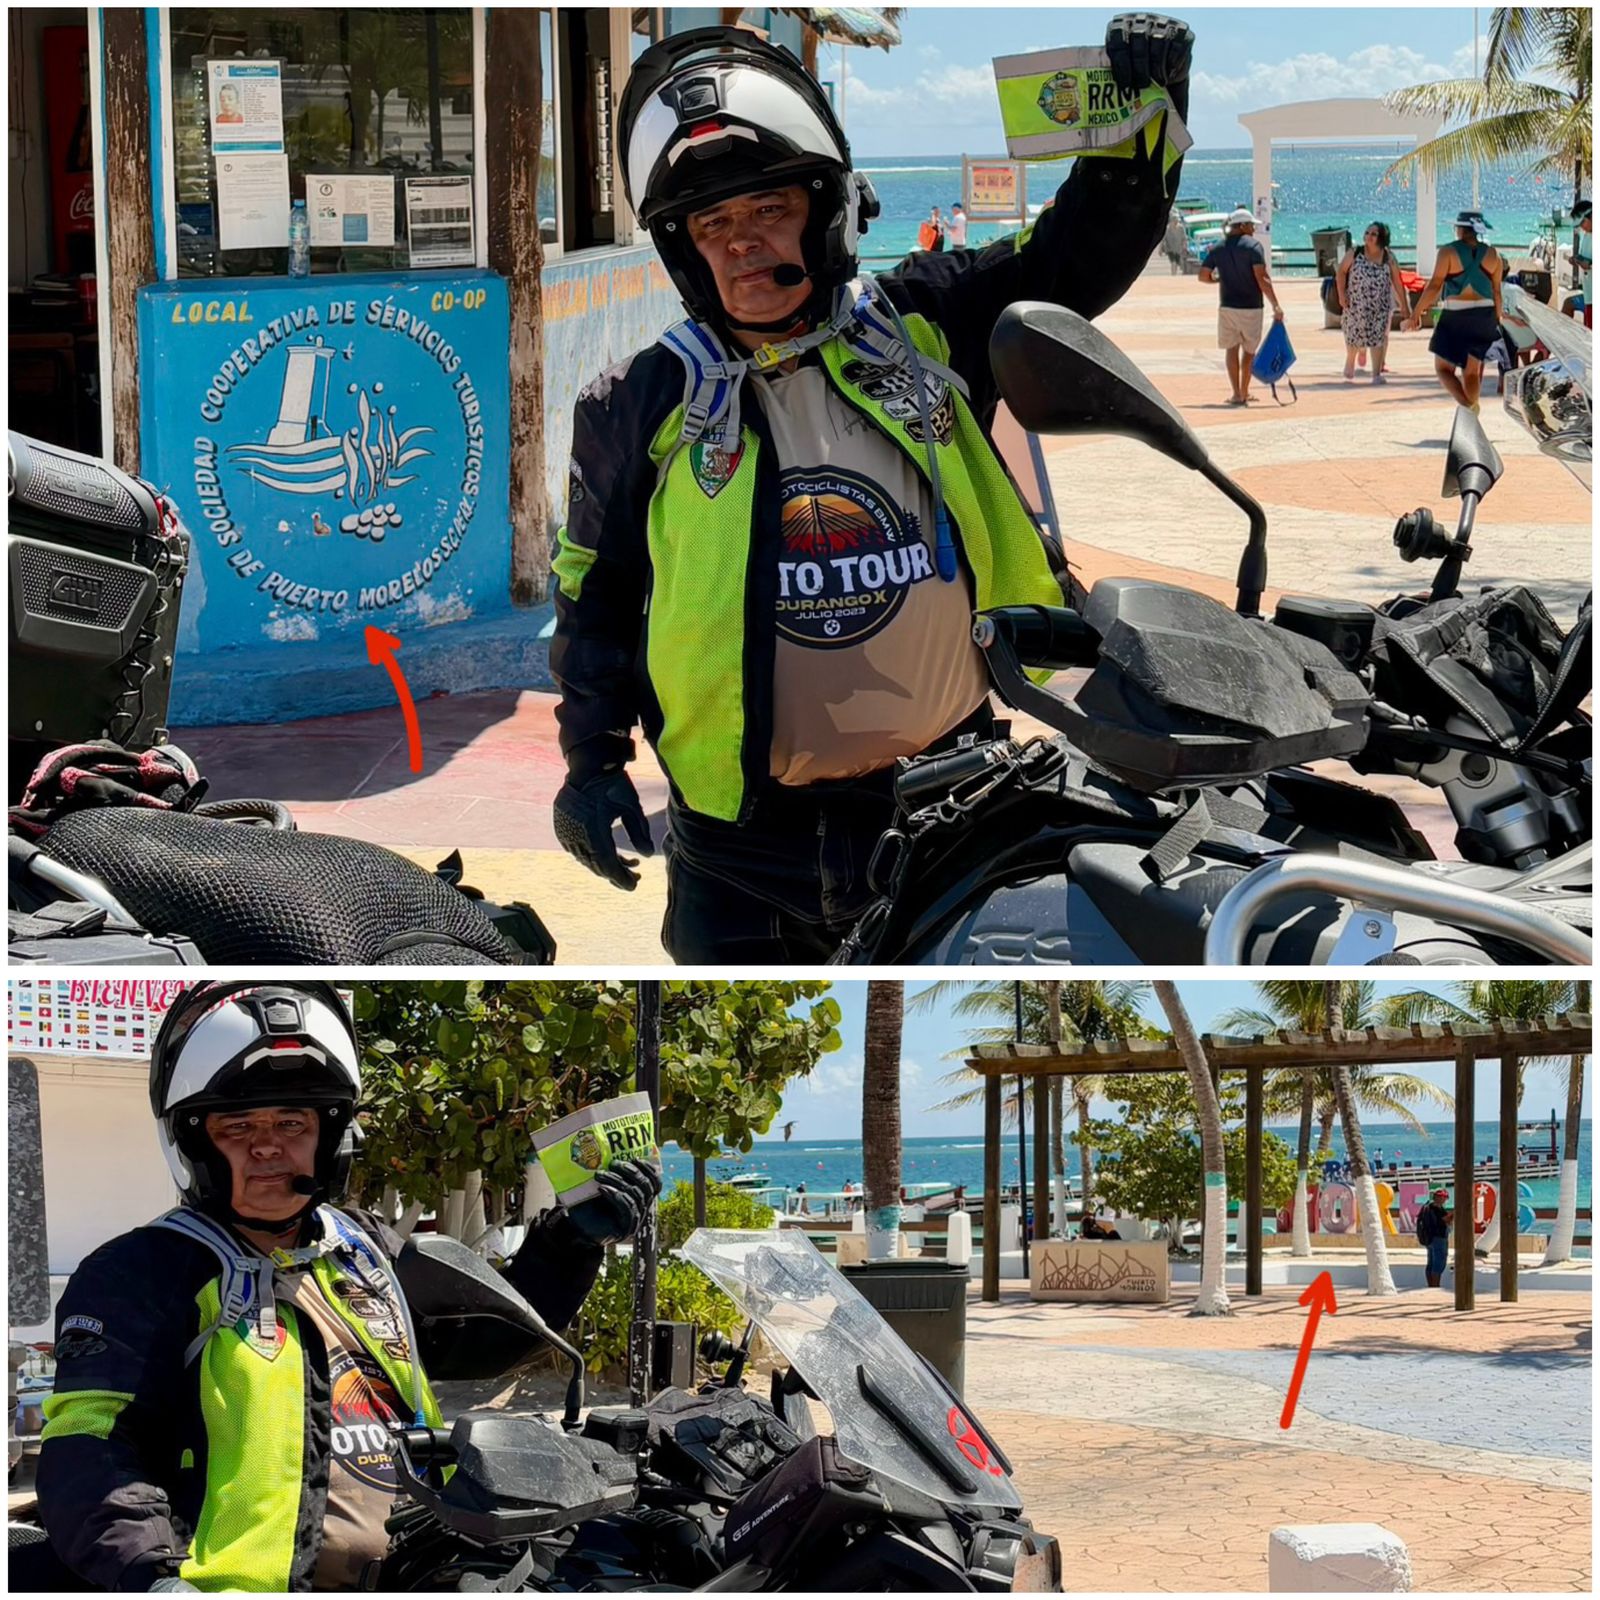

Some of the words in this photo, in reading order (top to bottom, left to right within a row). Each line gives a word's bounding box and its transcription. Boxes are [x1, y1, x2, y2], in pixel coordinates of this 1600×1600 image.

[1086, 70, 1116, 82] MOTOT
[171, 300, 254, 324] LOCAL
[328, 300, 357, 324] DE
[431, 288, 486, 312] CO-OP
[201, 305, 320, 421] COOPERATIVA
[453, 372, 484, 496] TURISTICOS
[194, 436, 241, 548] SOCIEDAD
[781, 481, 876, 511] OTOCICLISTAS
[873, 507, 896, 542] BMW
[227, 549, 265, 578] DE
[257, 571, 349, 613] PUERTO
[357, 547, 442, 611] MORELOS
[777, 562, 824, 597] TO
[830, 542, 934, 593] TOUR
[795, 610, 833, 620] JULIO
[834, 607, 866, 618] 2023
[1276, 1182, 1537, 1235] MOREOS
[330, 1423, 388, 1455] OTO
[732, 1520, 750, 1542] GS
[751, 1494, 790, 1528] ADVENTURE
